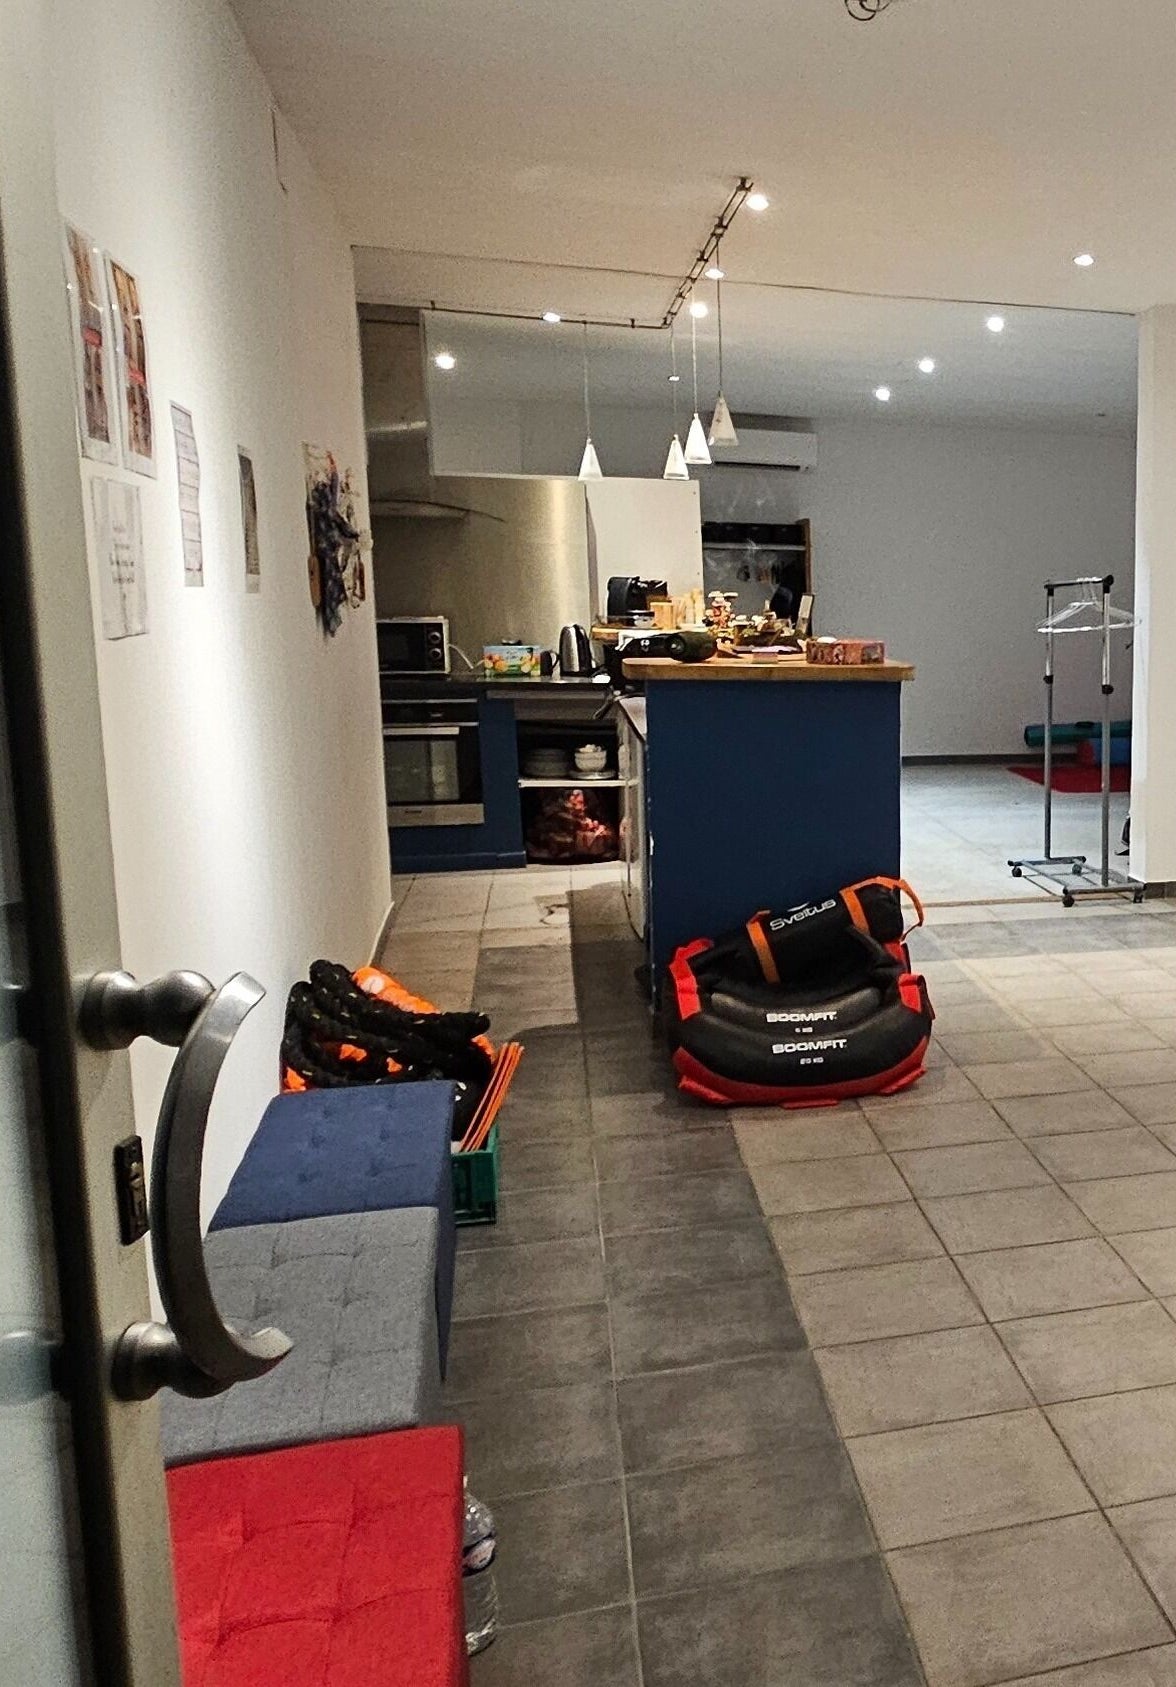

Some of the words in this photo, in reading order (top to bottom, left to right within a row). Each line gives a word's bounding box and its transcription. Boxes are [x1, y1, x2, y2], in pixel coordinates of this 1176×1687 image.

[769, 899, 836, 931] Sveltus
[766, 1011, 837, 1022] BOOMFIT
[772, 1039, 847, 1054] BOOMFIT
